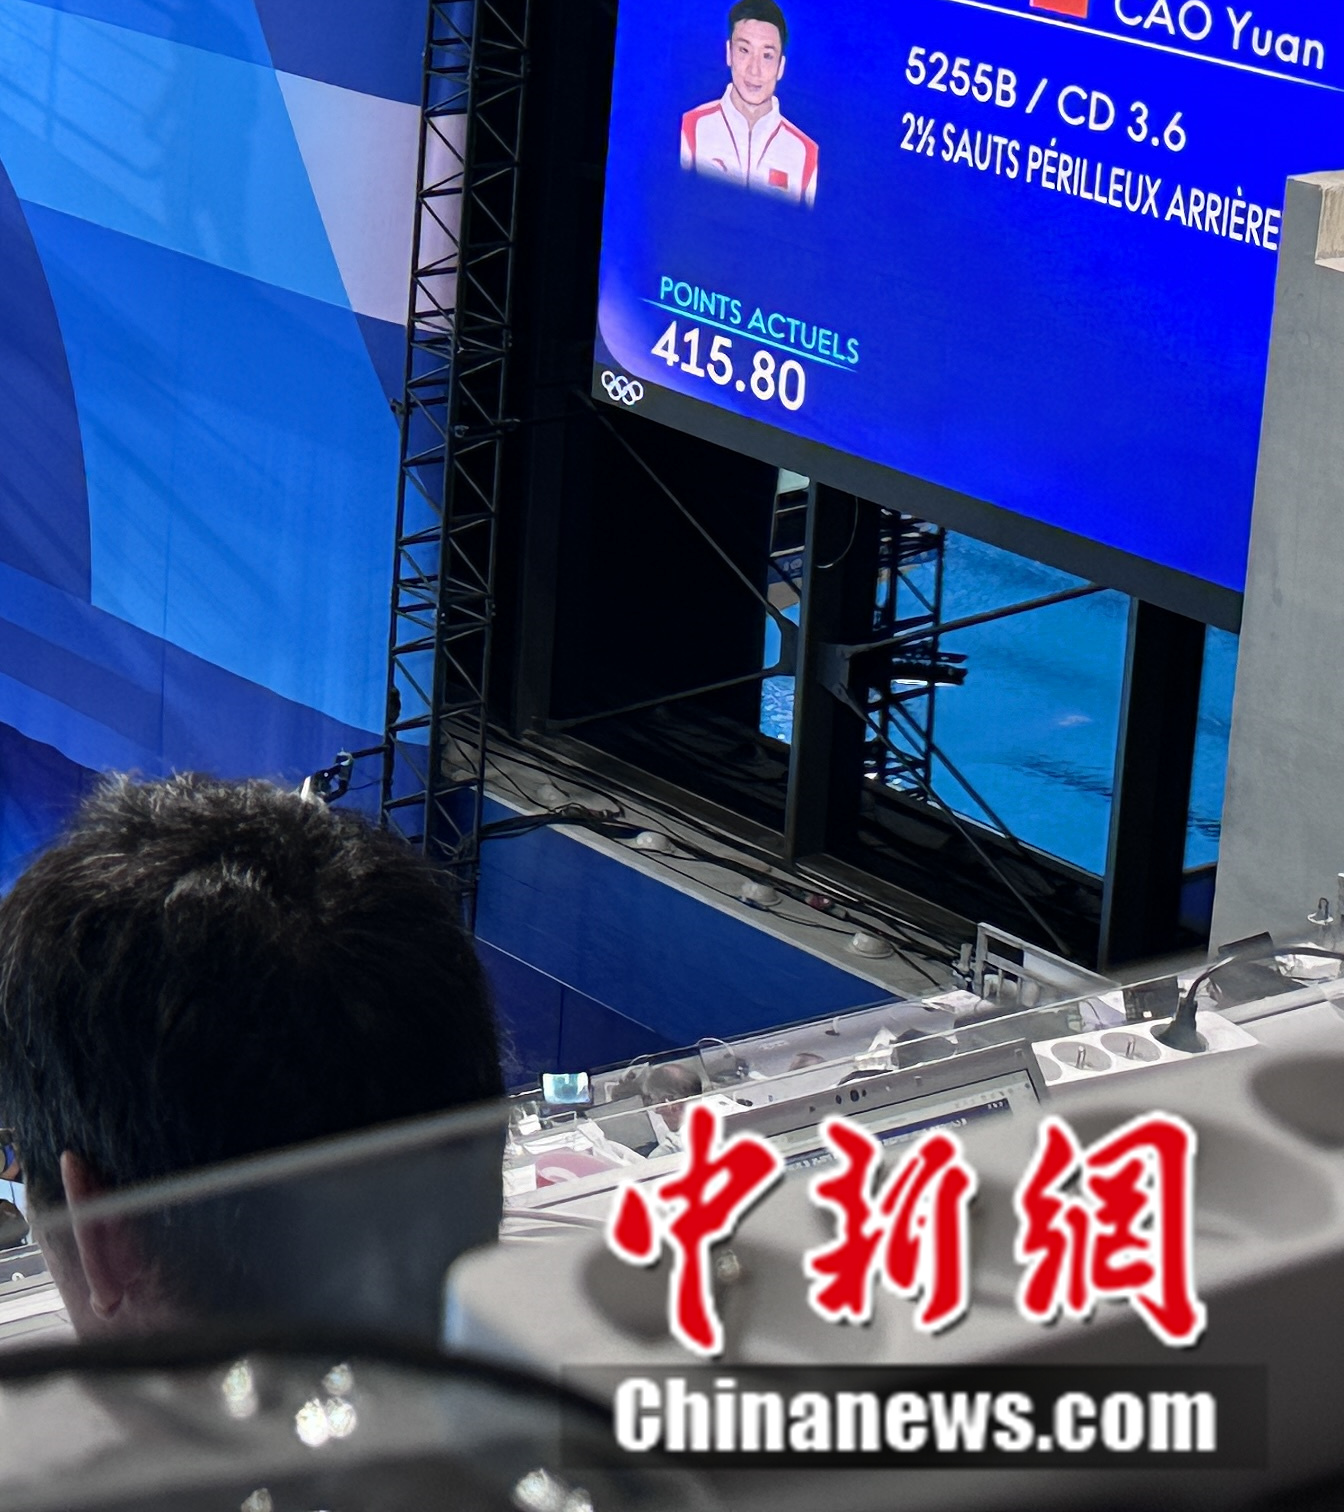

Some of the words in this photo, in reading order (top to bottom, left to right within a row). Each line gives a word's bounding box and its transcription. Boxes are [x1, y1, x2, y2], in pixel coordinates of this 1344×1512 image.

[1226, 6, 1325, 70] Yuan
[905, 45, 1017, 108] 5255B
[1025, 78, 1048, 114] /
[1058, 85, 1115, 131] CD
[1127, 101, 1188, 152] 3.6
[941, 122, 1020, 179] SAUTS
[1026, 137, 1162, 219] PÉRILLEUX
[1165, 185, 1282, 251] ARRIÈRE
[651, 320, 806, 411] 415.80
[660, 276, 741, 324] POINTS
[747, 307, 859, 364] ACTUELS
